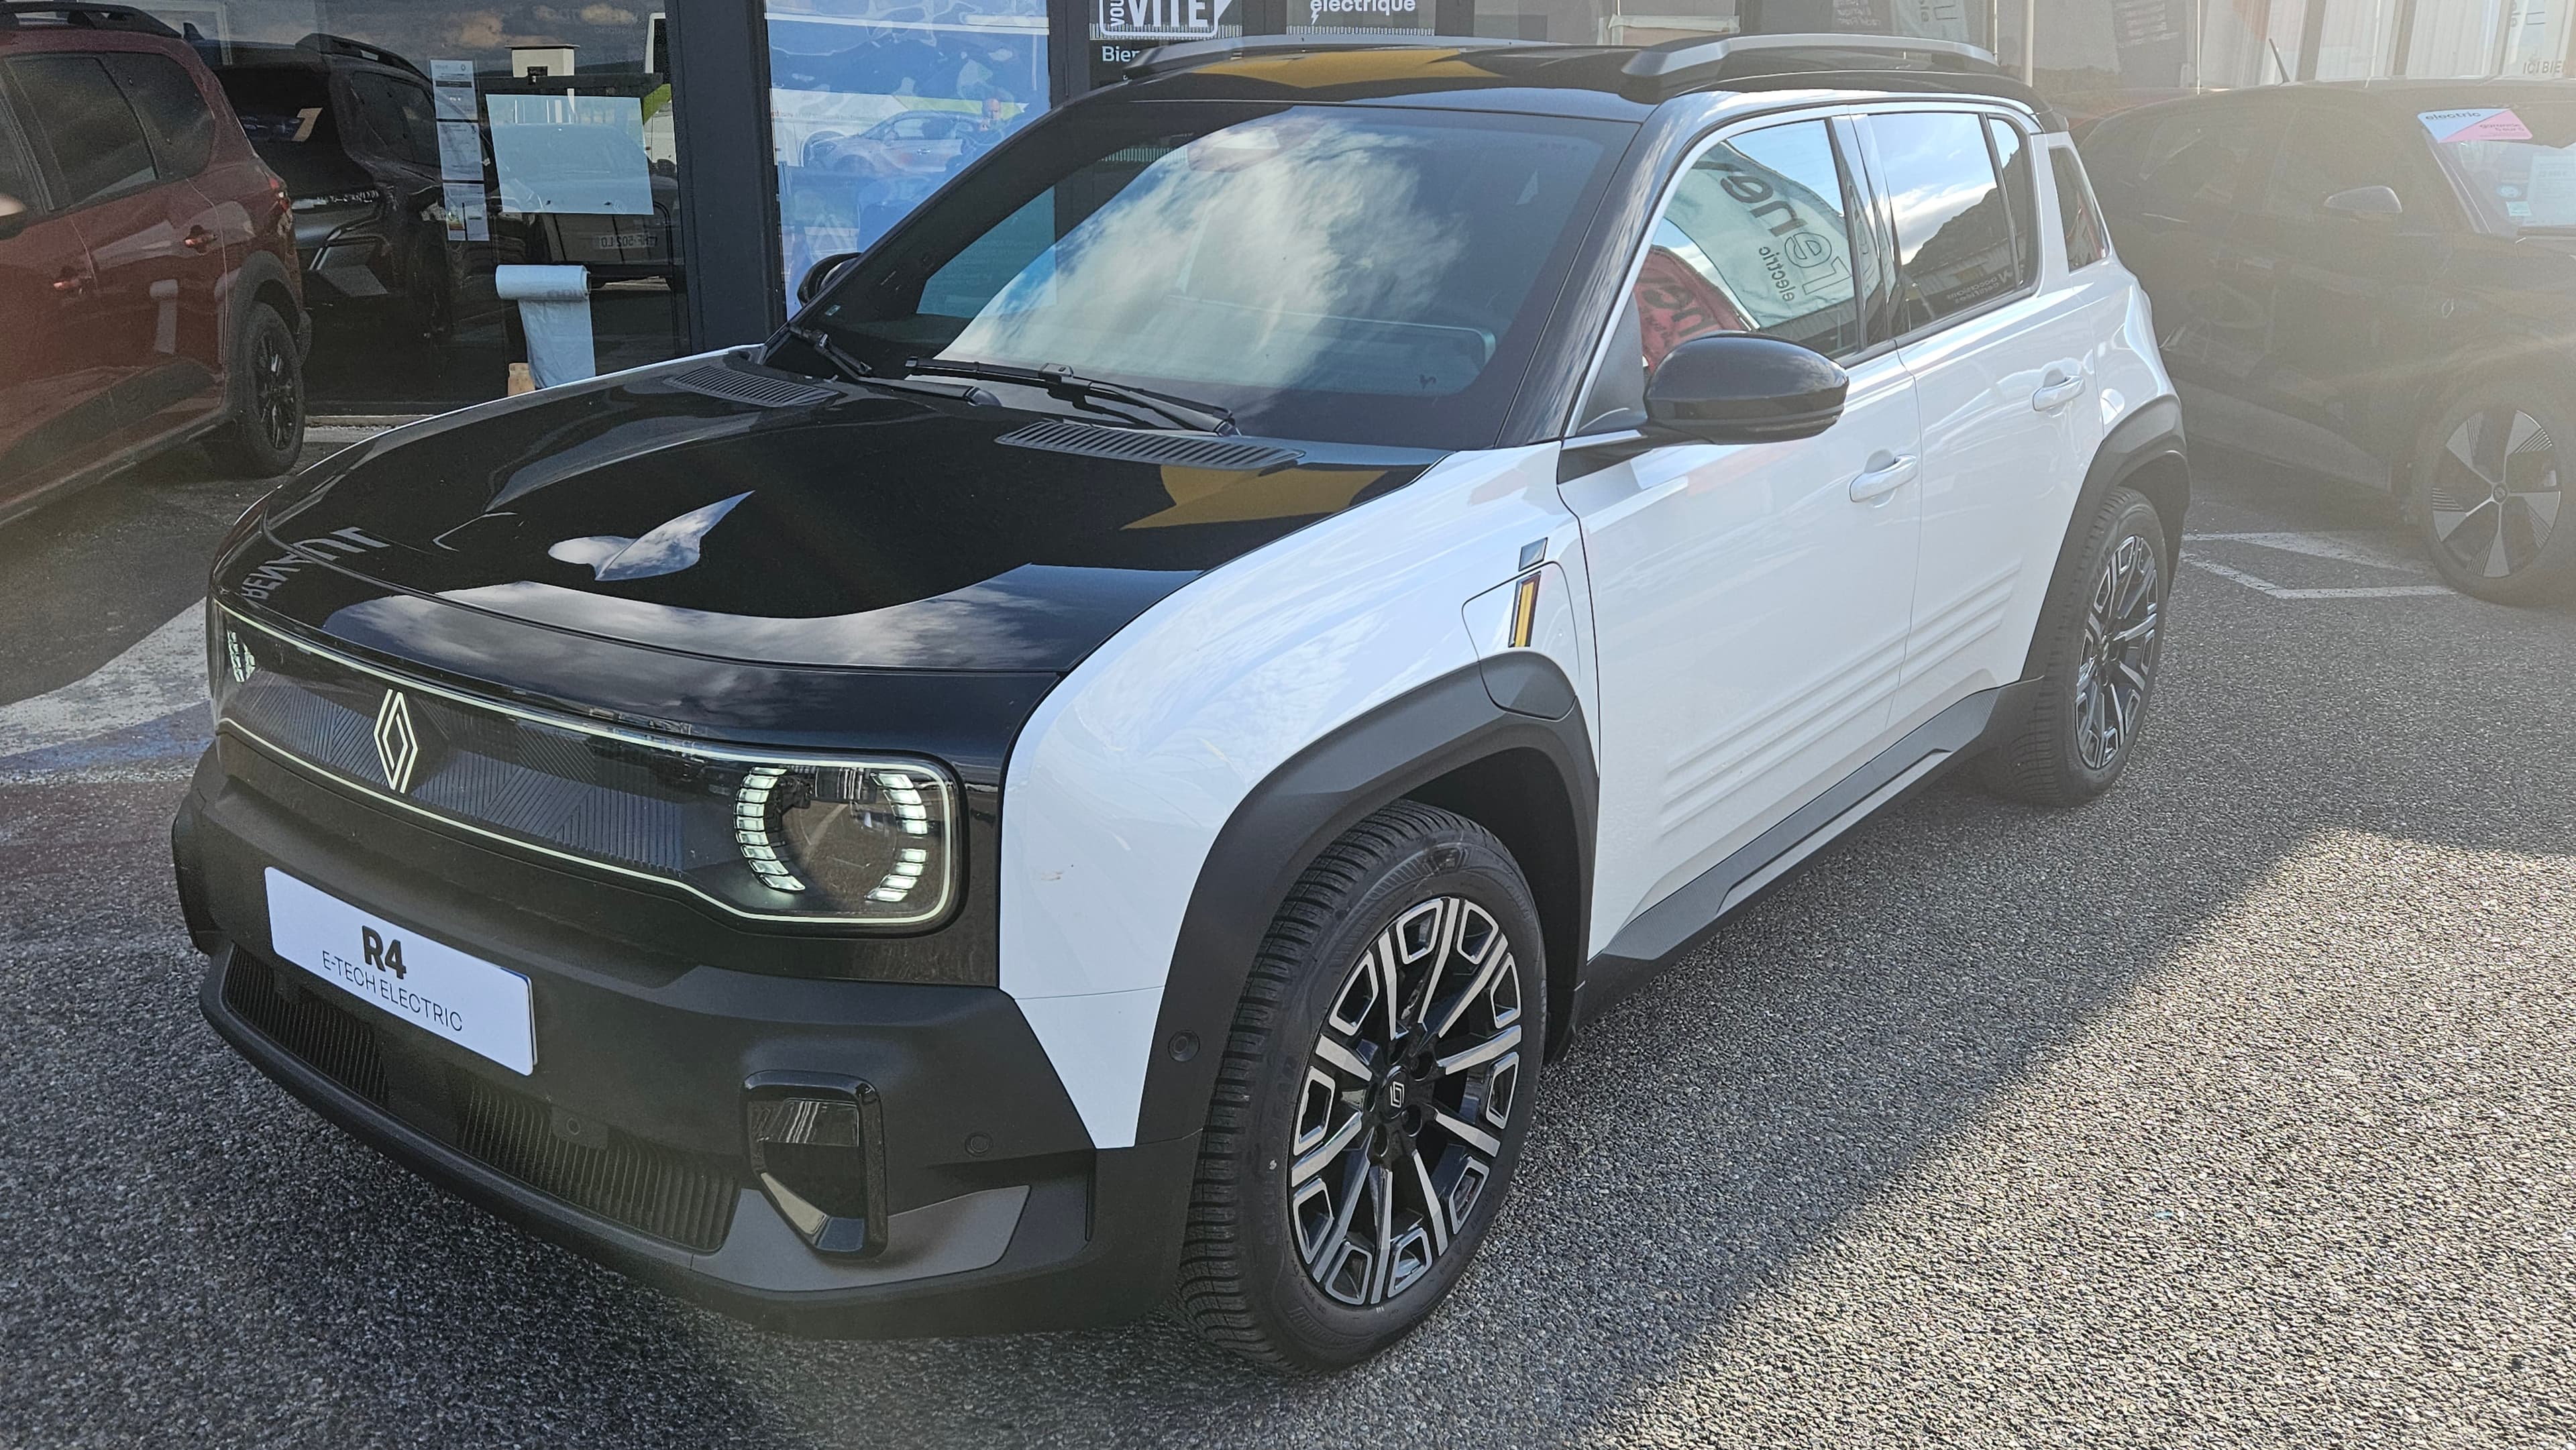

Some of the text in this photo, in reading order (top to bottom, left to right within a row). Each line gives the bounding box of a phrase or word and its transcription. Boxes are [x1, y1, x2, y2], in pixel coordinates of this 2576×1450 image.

[2425, 111, 2481, 120] electric
[362, 925, 407, 980] R4
[322, 950, 463, 1031] E-TECH ELECTRIC
